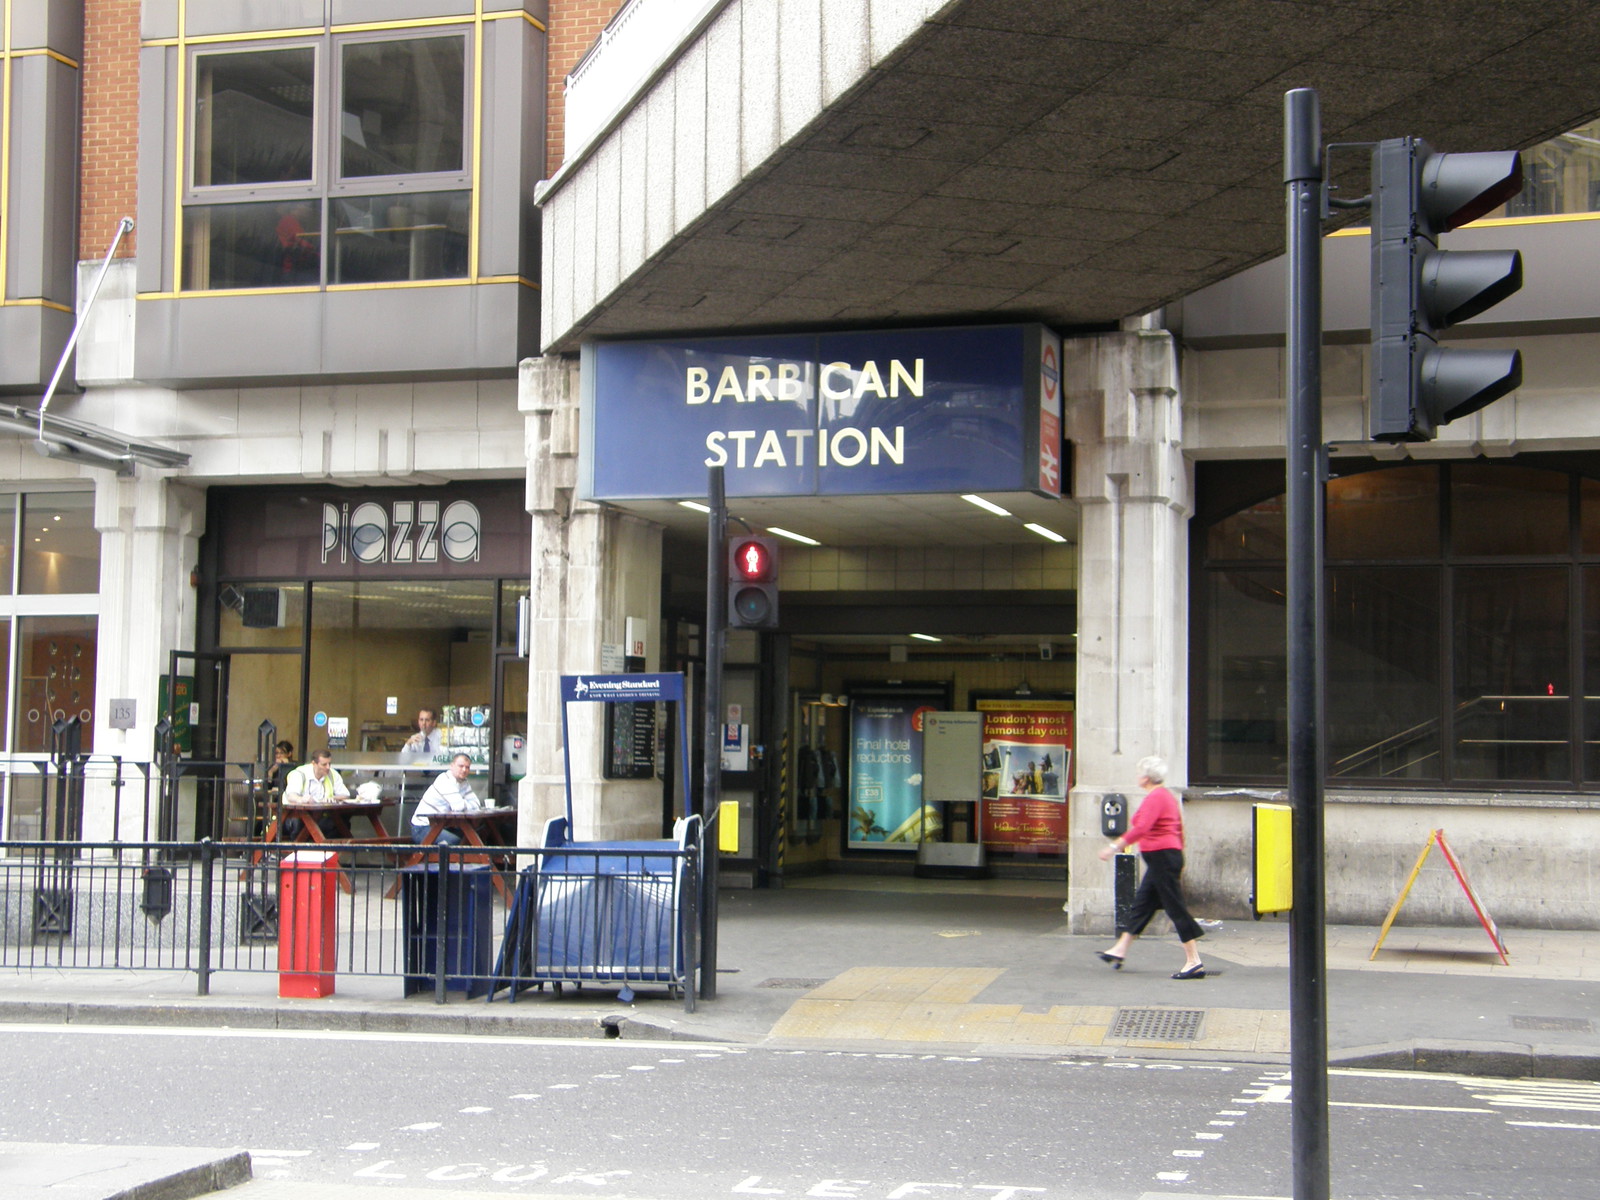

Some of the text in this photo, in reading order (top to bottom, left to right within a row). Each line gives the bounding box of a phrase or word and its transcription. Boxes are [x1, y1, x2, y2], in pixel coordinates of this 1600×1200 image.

[686, 358, 924, 405] BARBICAN
[704, 426, 904, 468] STATION
[589, 680, 660, 690] Evening Standard
[115, 708, 131, 720] 135
[986, 715, 1066, 724] London's most
[984, 725, 1068, 738] famous day out
[857, 738, 910, 751] Final hotel
[857, 752, 912, 764] reductions
[353, 1159, 1047, 1200] LOOK LEFT
